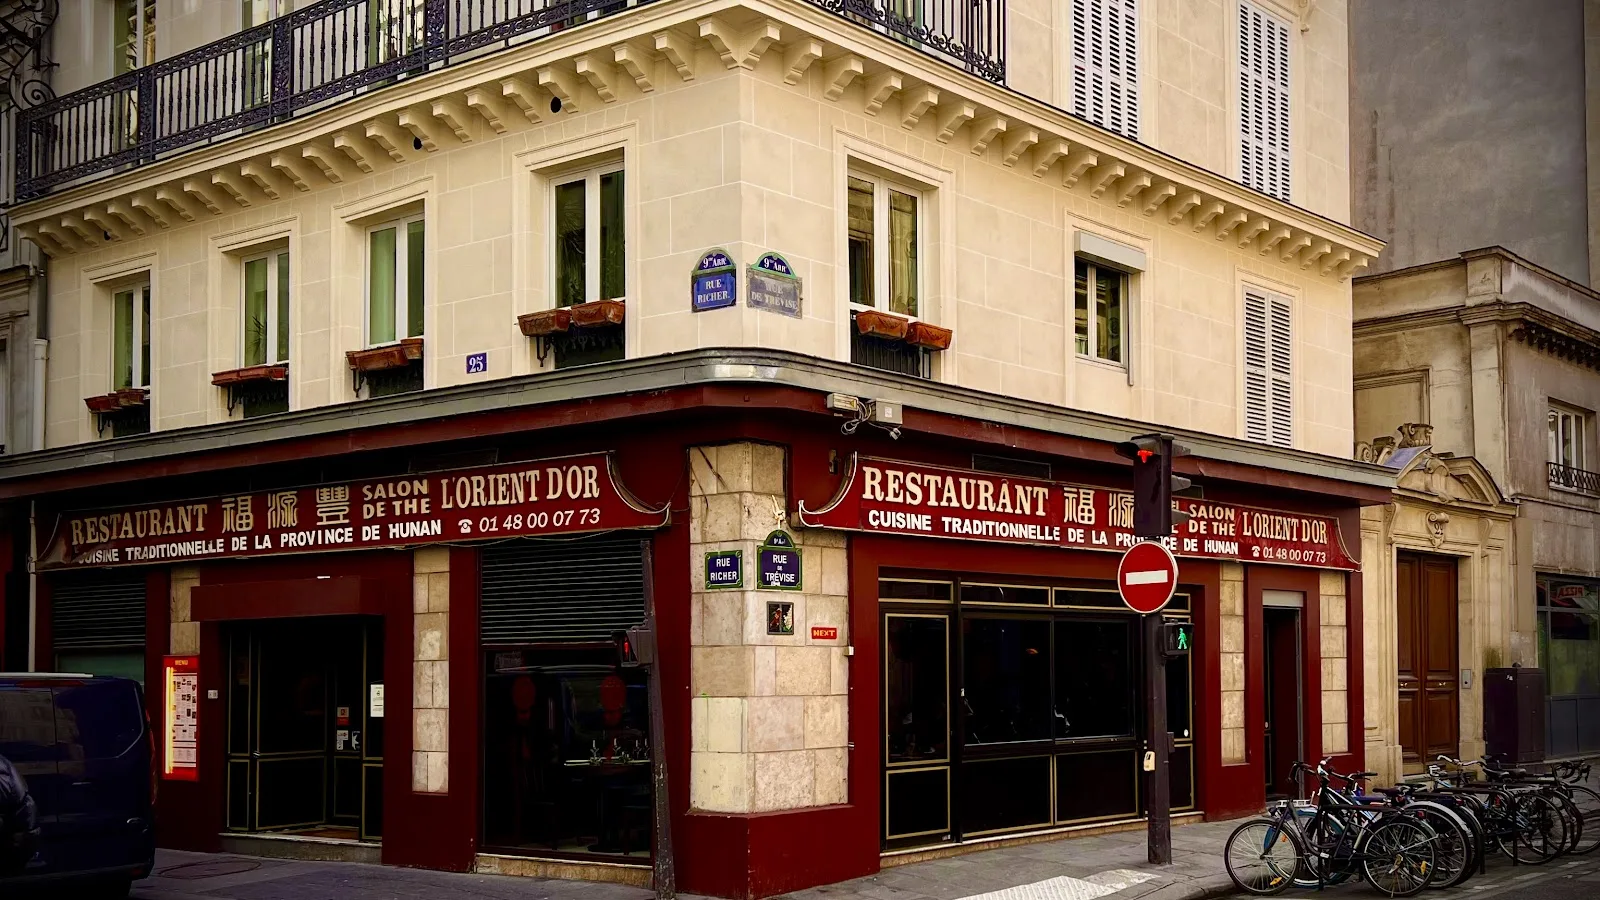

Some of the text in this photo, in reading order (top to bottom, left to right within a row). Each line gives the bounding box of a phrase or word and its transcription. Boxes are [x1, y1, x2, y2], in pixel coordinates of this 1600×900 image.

[705, 279, 722, 290] RUE
[765, 282, 783, 294] RUE
[751, 291, 762, 302] DE
[469, 356, 483, 373] 25
[362, 478, 429, 501] SALON
[441, 464, 600, 510] L'ORIENT D'OR
[862, 466, 1049, 517] RESTAURANT
[362, 497, 431, 520] DE THE
[1189, 503, 1235, 521] SALON
[71, 503, 208, 547] RESTAURANT
[479, 507, 601, 533] 01 48 00 07 73
[1188, 519, 1236, 537] DE THE
[1242, 511, 1328, 545] L'ORIENT D'OR
[125, 538, 225, 561] TRADITIONNELLE
[231, 536, 248, 552] DE
[255, 534, 272, 550] LA
[280, 527, 354, 548] PROVINCE
[362, 524, 381, 541] DE
[388, 519, 442, 540] HUNAN
[868, 509, 932, 532] CUISINE
[941, 516, 1061, 541] TRADITIONNELLE
[1067, 528, 1085, 544] DE
[1092, 530, 1108, 546] LA
[1183, 538, 1198, 553] DE
[1204, 539, 1239, 556] HUNAN
[716, 557, 731, 568] RUE
[772, 554, 788, 564] RUE
[1263, 546, 1326, 563] 01 48 00 07 73
[710, 571, 738, 581] RICHER
[765, 571, 796, 583] TRÉVISE
[813, 629, 836, 637] NEXT
